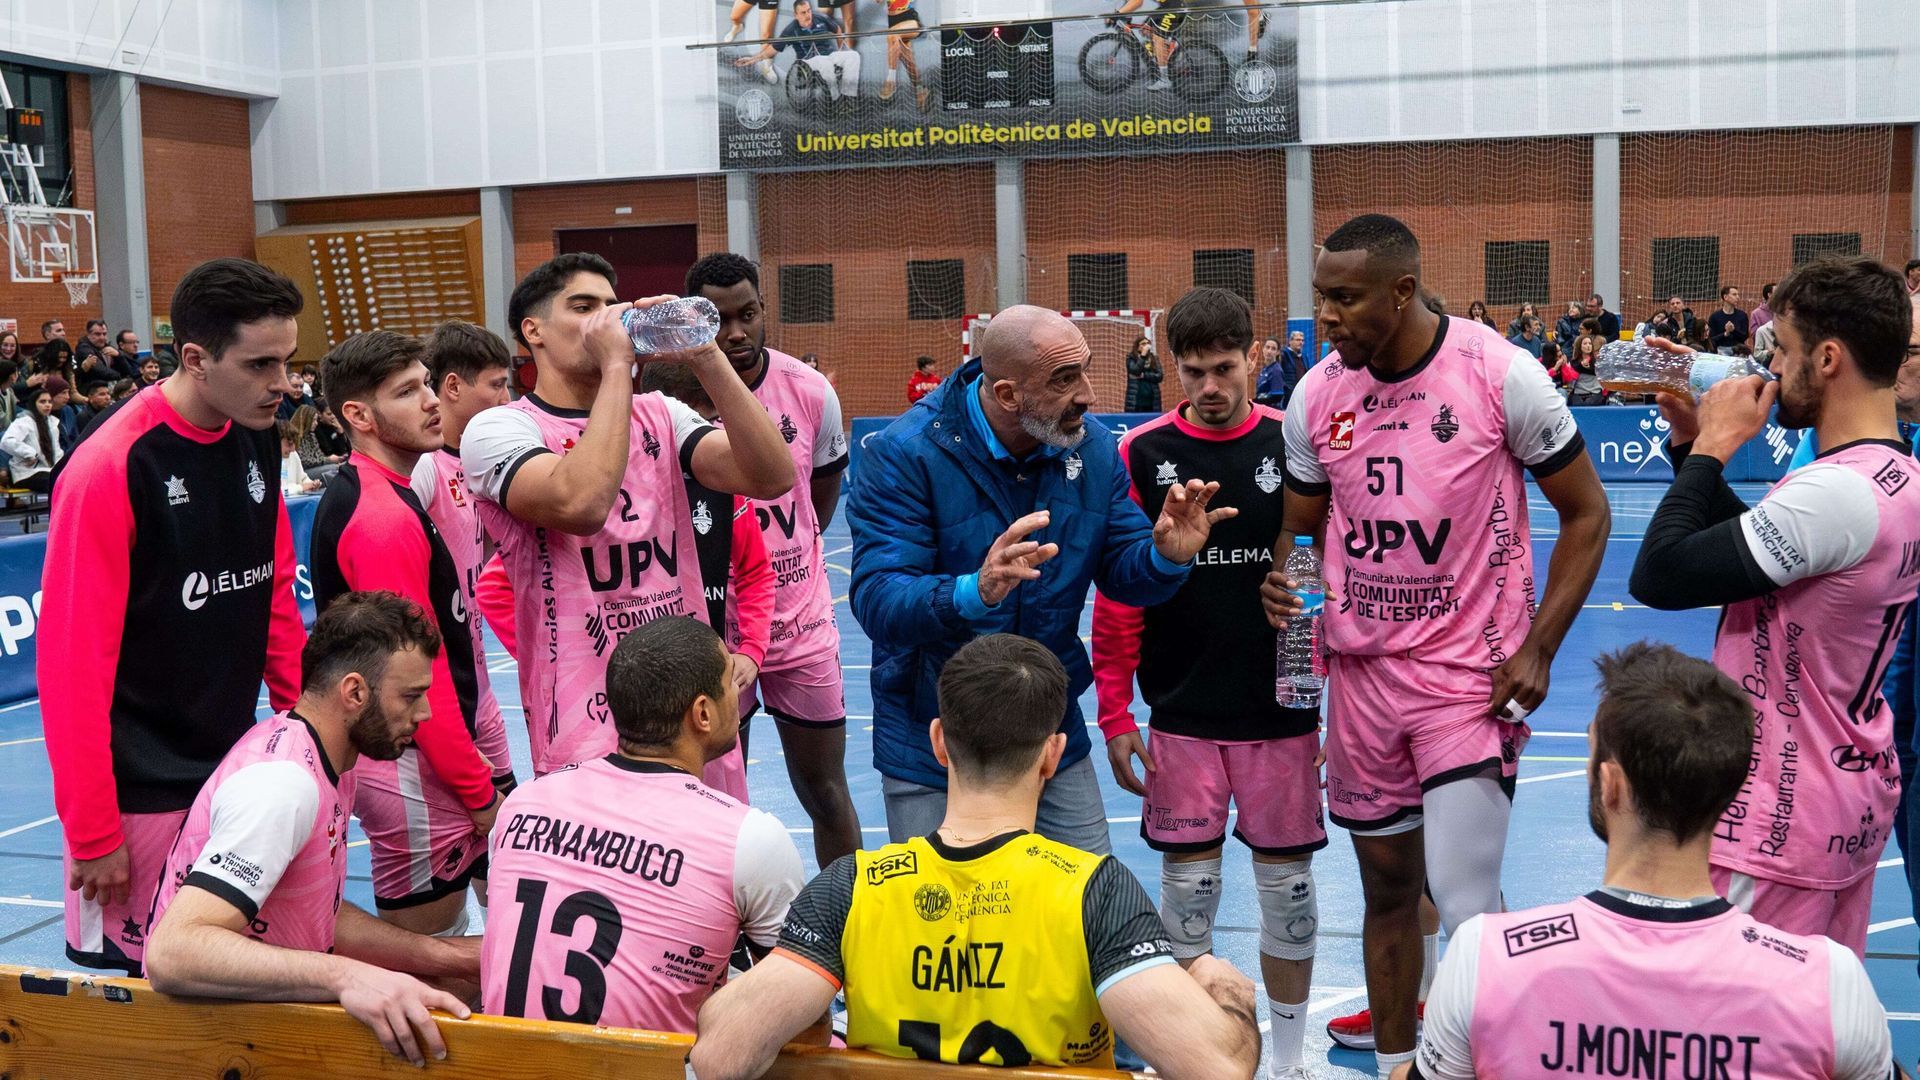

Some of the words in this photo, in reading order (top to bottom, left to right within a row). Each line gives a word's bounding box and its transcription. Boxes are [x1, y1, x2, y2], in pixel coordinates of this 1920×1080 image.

[945, 47, 975, 57] LOCAL
[1019, 44, 1049, 53] VISITANTE
[947, 102, 969, 110] FALTAS
[984, 100, 1011, 109] JUGADOR
[1029, 99, 1051, 107] FALTAS
[1226, 106, 1286, 116] UNIVERSITAT
[728, 131, 782, 142] UNIVERSITAT
[796, 127, 924, 152] Universitat
[929, 121, 1060, 145] Politècnica
[1065, 118, 1096, 139] de
[1101, 112, 1211, 137] València
[1226, 126, 1238, 134] DE
[729, 149, 740, 159] DE
[1366, 456, 1403, 497] 57
[1880, 463, 1906, 489] TSK
[168, 494, 190, 506] luanvi
[1344, 518, 1452, 565] UPV
[580, 531, 678, 593] UPV
[1195, 546, 1274, 566] LÉLEMA
[212, 560, 274, 595] LÉLEMAN
[1353, 568, 1394, 584] Comunitat
[1397, 573, 1455, 585] Valenciana
[603, 595, 650, 611] Comunitat
[1352, 581, 1454, 604] COMUNITAT
[1358, 601, 1374, 619] DE
[545, 598, 558, 664] Viajes
[1331, 775, 1383, 802] Torres
[1759, 741, 1799, 858] Restaurante
[1155, 807, 1209, 828] Torres
[500, 813, 685, 888] PERNAMBUCO
[220, 864, 257, 888] ALFONSO
[224, 857, 260, 881] TRINIDAD
[1509, 923, 1571, 948] TSK
[503, 878, 623, 1026] 13
[663, 951, 716, 972] MAPFRE
[1540, 1020, 1761, 1080] J.MONFORT
